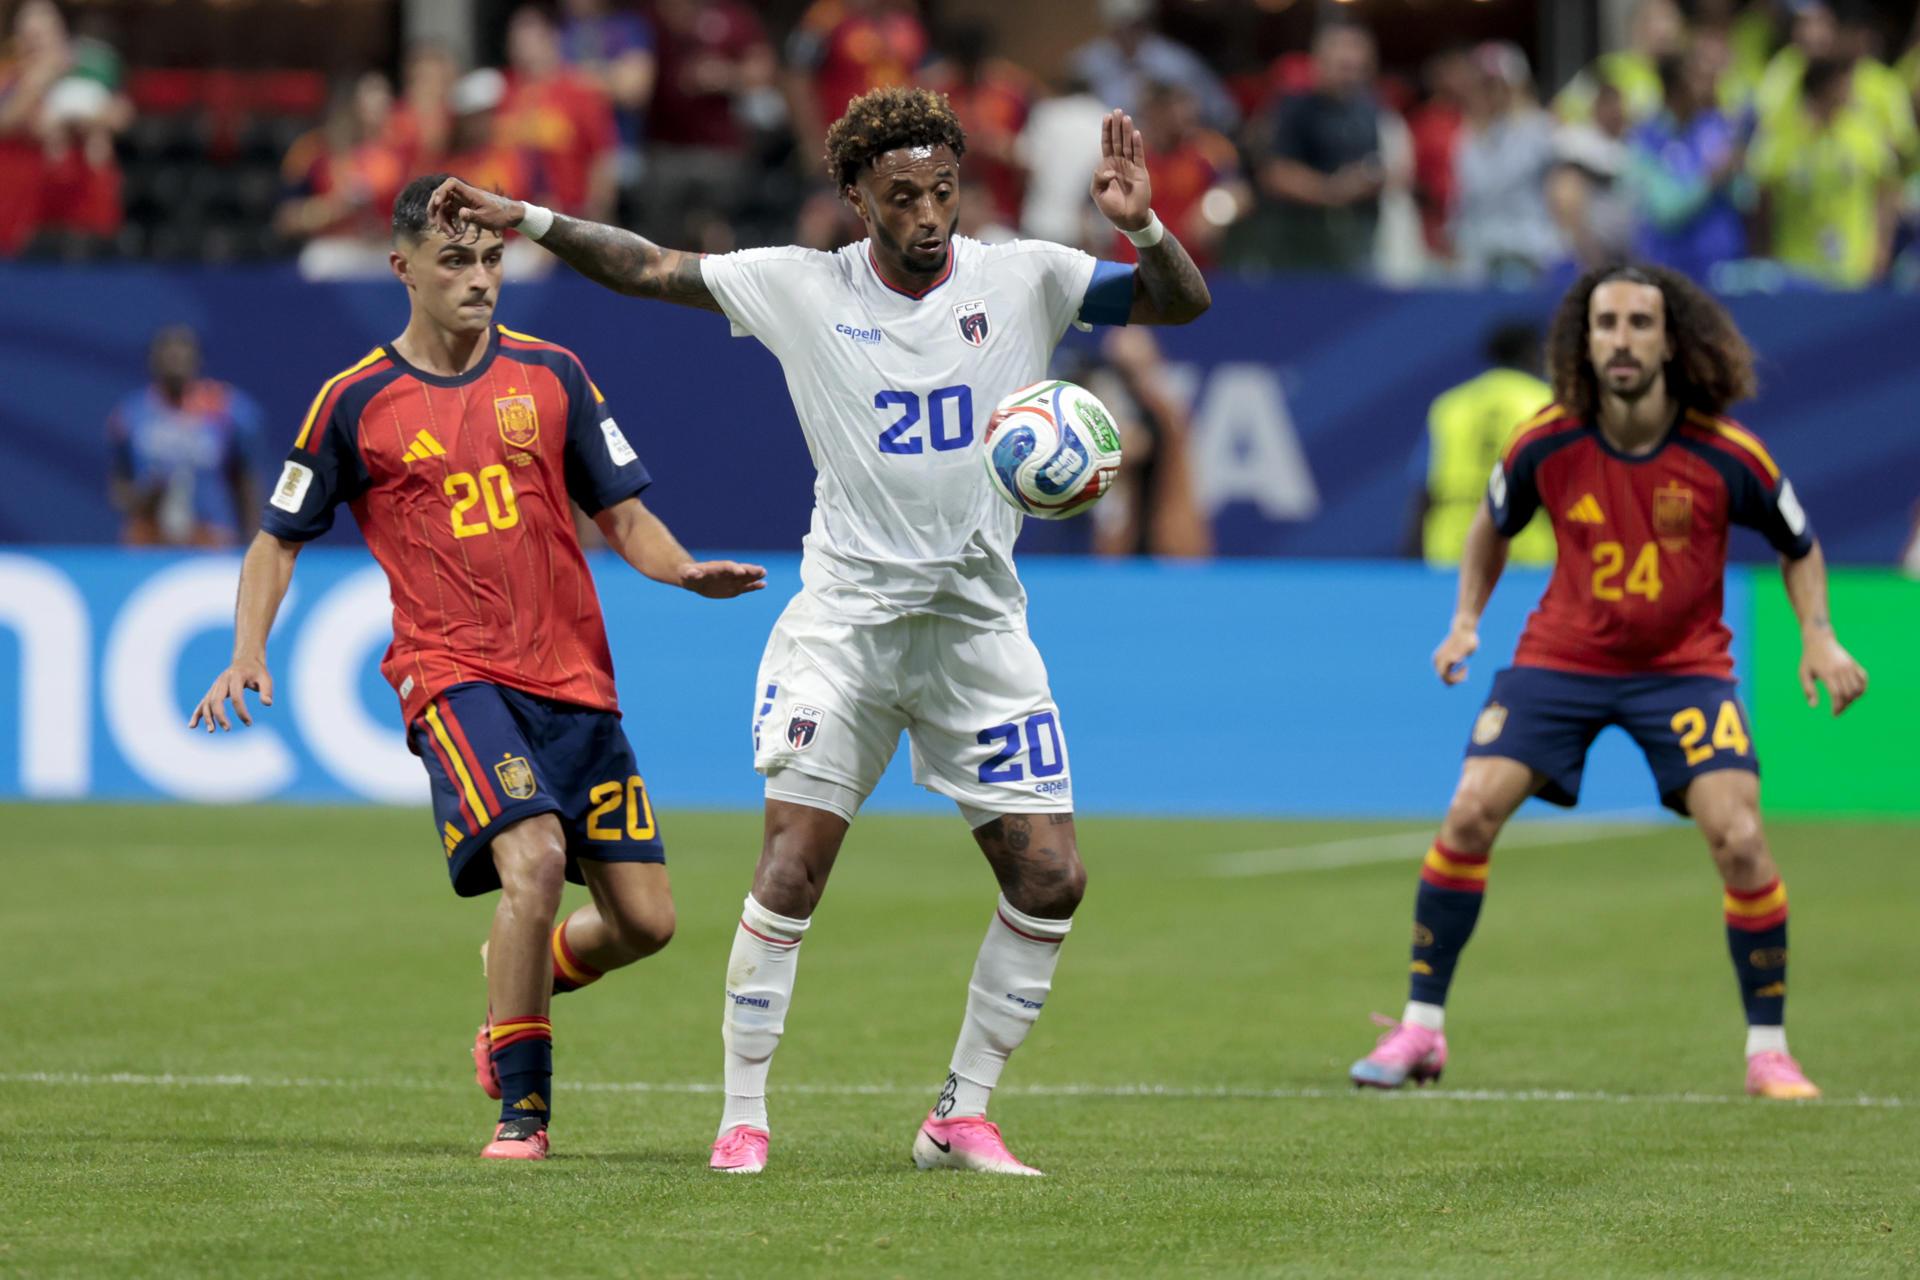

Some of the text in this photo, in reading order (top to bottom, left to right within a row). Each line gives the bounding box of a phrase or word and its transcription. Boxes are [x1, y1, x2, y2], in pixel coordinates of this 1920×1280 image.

[836, 323, 881, 341] capelli
[956, 301, 983, 314] FCF
[874, 384, 974, 455] 20
[1165, 362, 1320, 520] A
[444, 464, 519, 539] 20
[1592, 541, 1663, 601] 24
[794, 705, 821, 718] FCF
[1671, 700, 1749, 766] 24
[977, 712, 1063, 783] 20
[586, 775, 655, 841] 20
